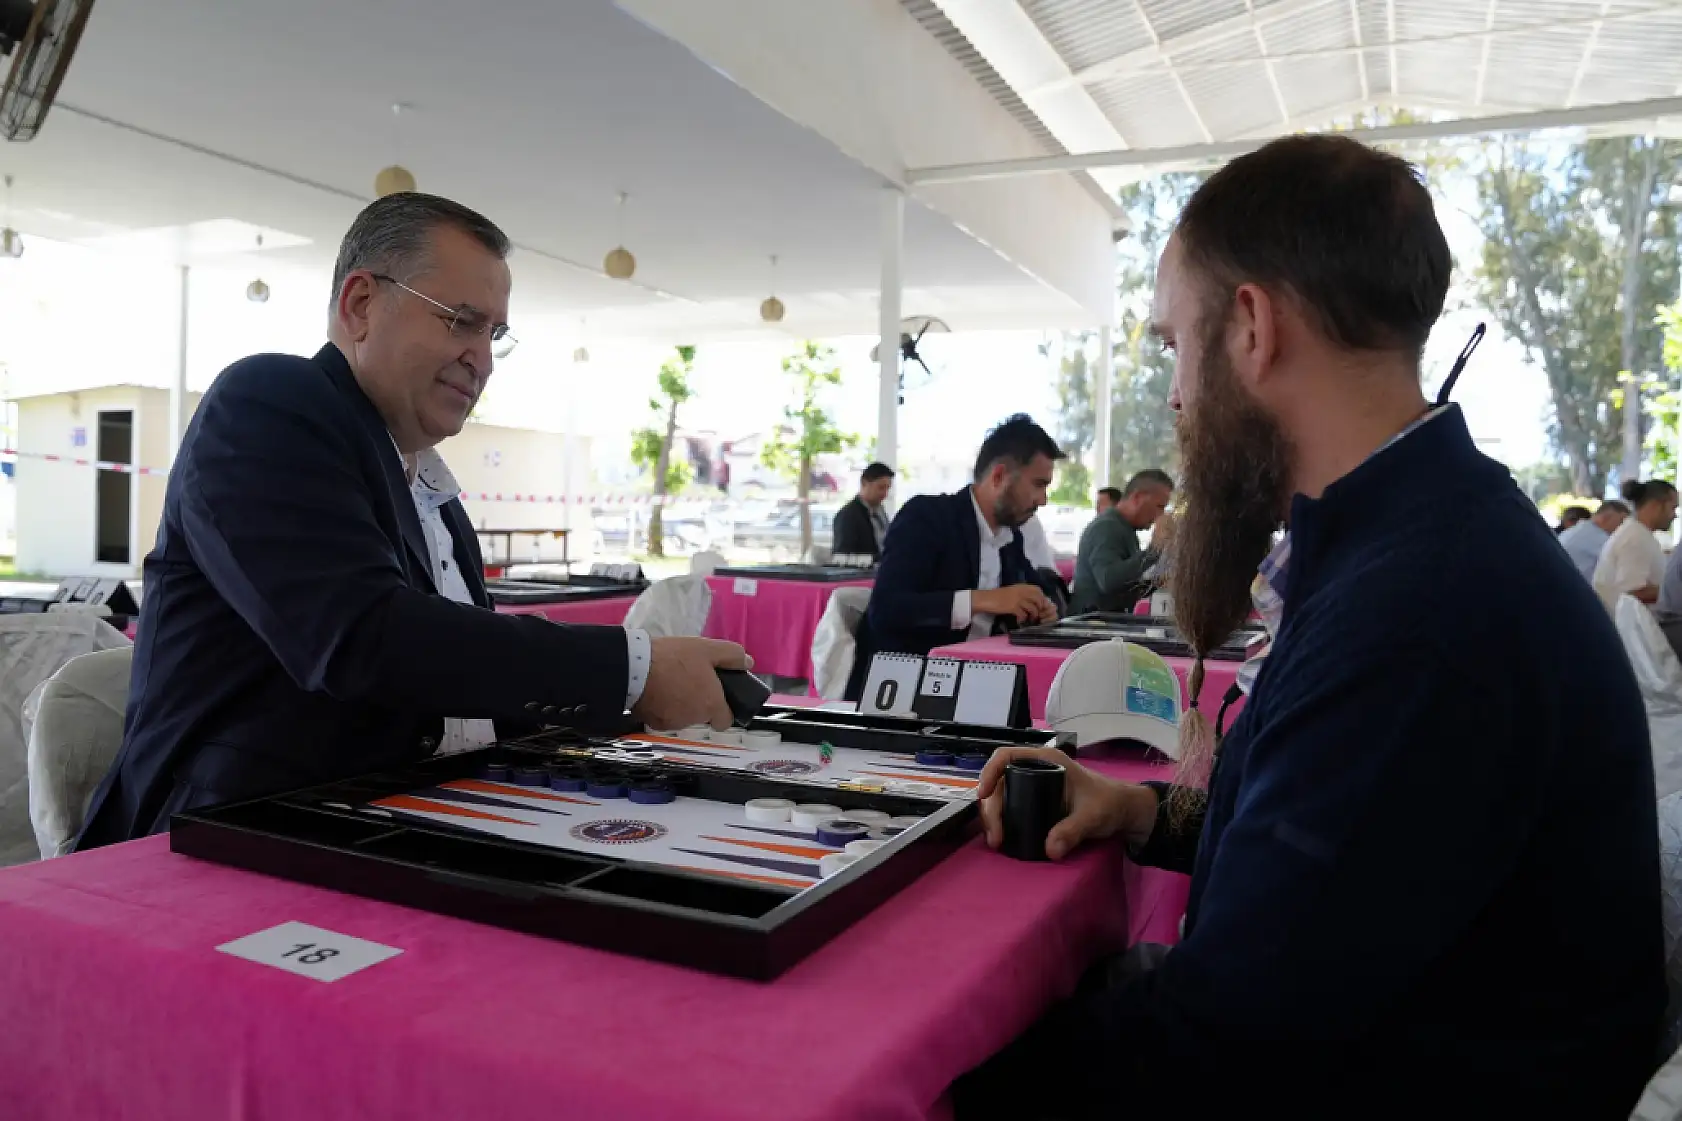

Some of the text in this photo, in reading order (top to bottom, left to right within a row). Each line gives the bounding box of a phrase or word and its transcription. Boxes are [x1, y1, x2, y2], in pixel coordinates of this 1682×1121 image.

[875, 679, 898, 711] 0
[932, 681, 941, 693] 5
[281, 943, 340, 964] 18
